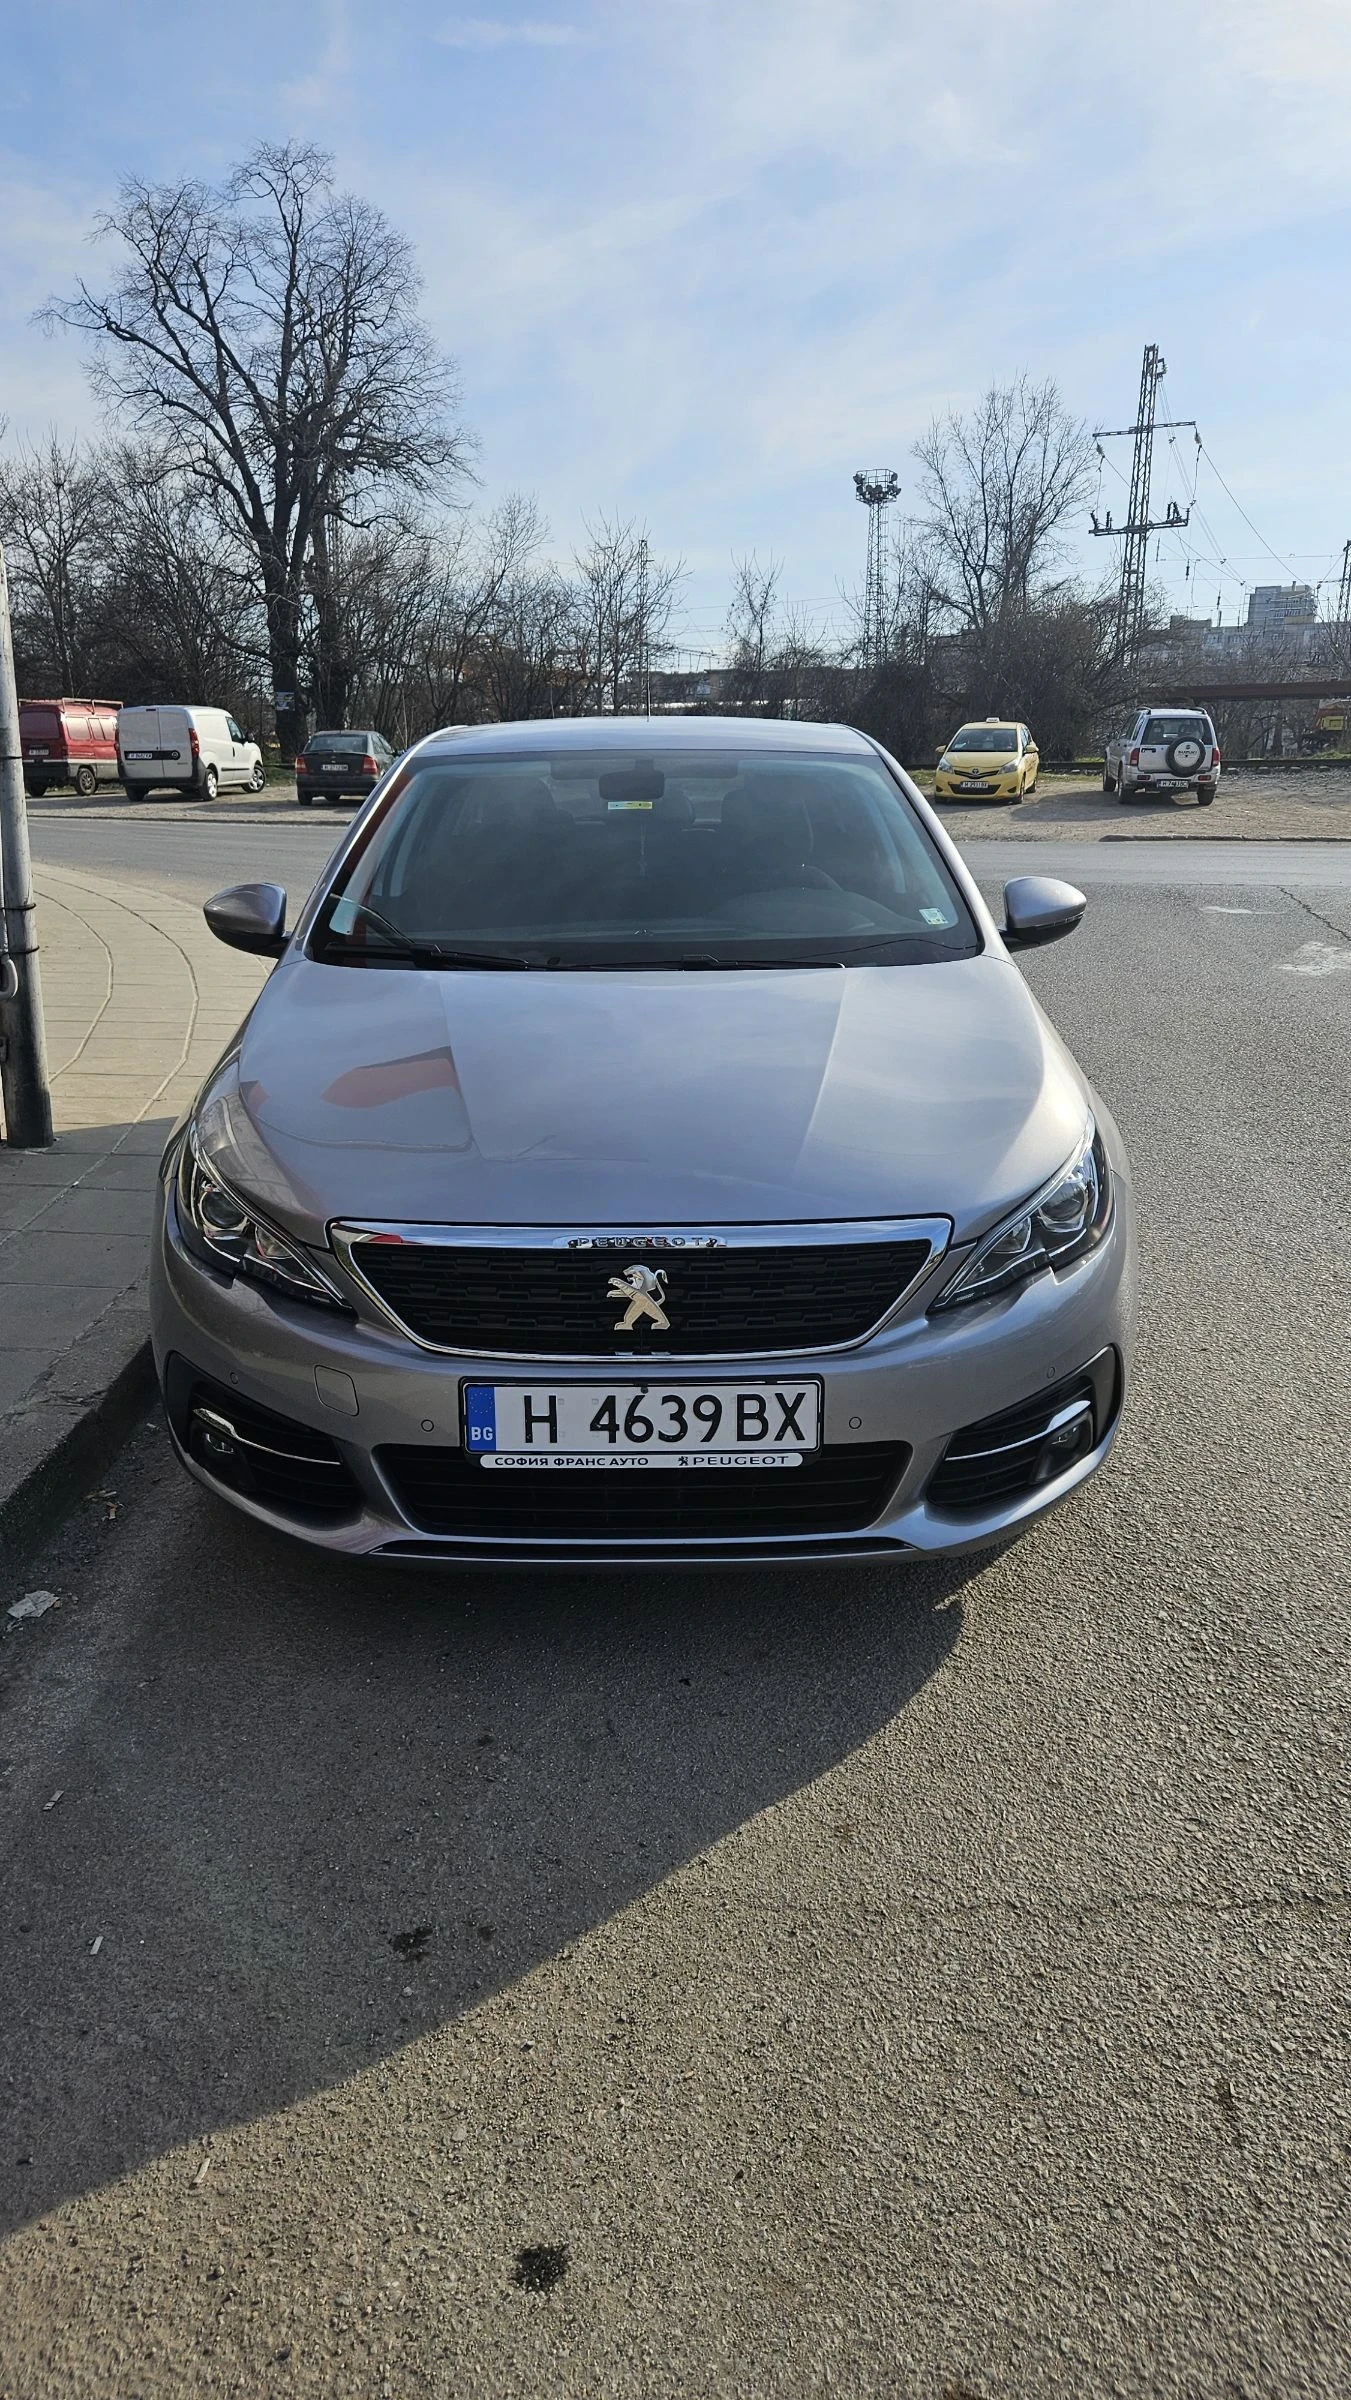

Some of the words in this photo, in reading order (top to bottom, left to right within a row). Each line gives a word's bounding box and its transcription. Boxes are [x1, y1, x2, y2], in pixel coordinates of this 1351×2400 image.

[577, 1236, 704, 1248] PEUGEOT
[523, 1395, 558, 1443] H
[471, 1427, 494, 1441] BG
[494, 1457, 549, 1466] СОФИЯ
[553, 1457, 606, 1467] ФРАНС
[609, 1457, 650, 1466] АУТО
[693, 1456, 790, 1465] PEUGEOT
